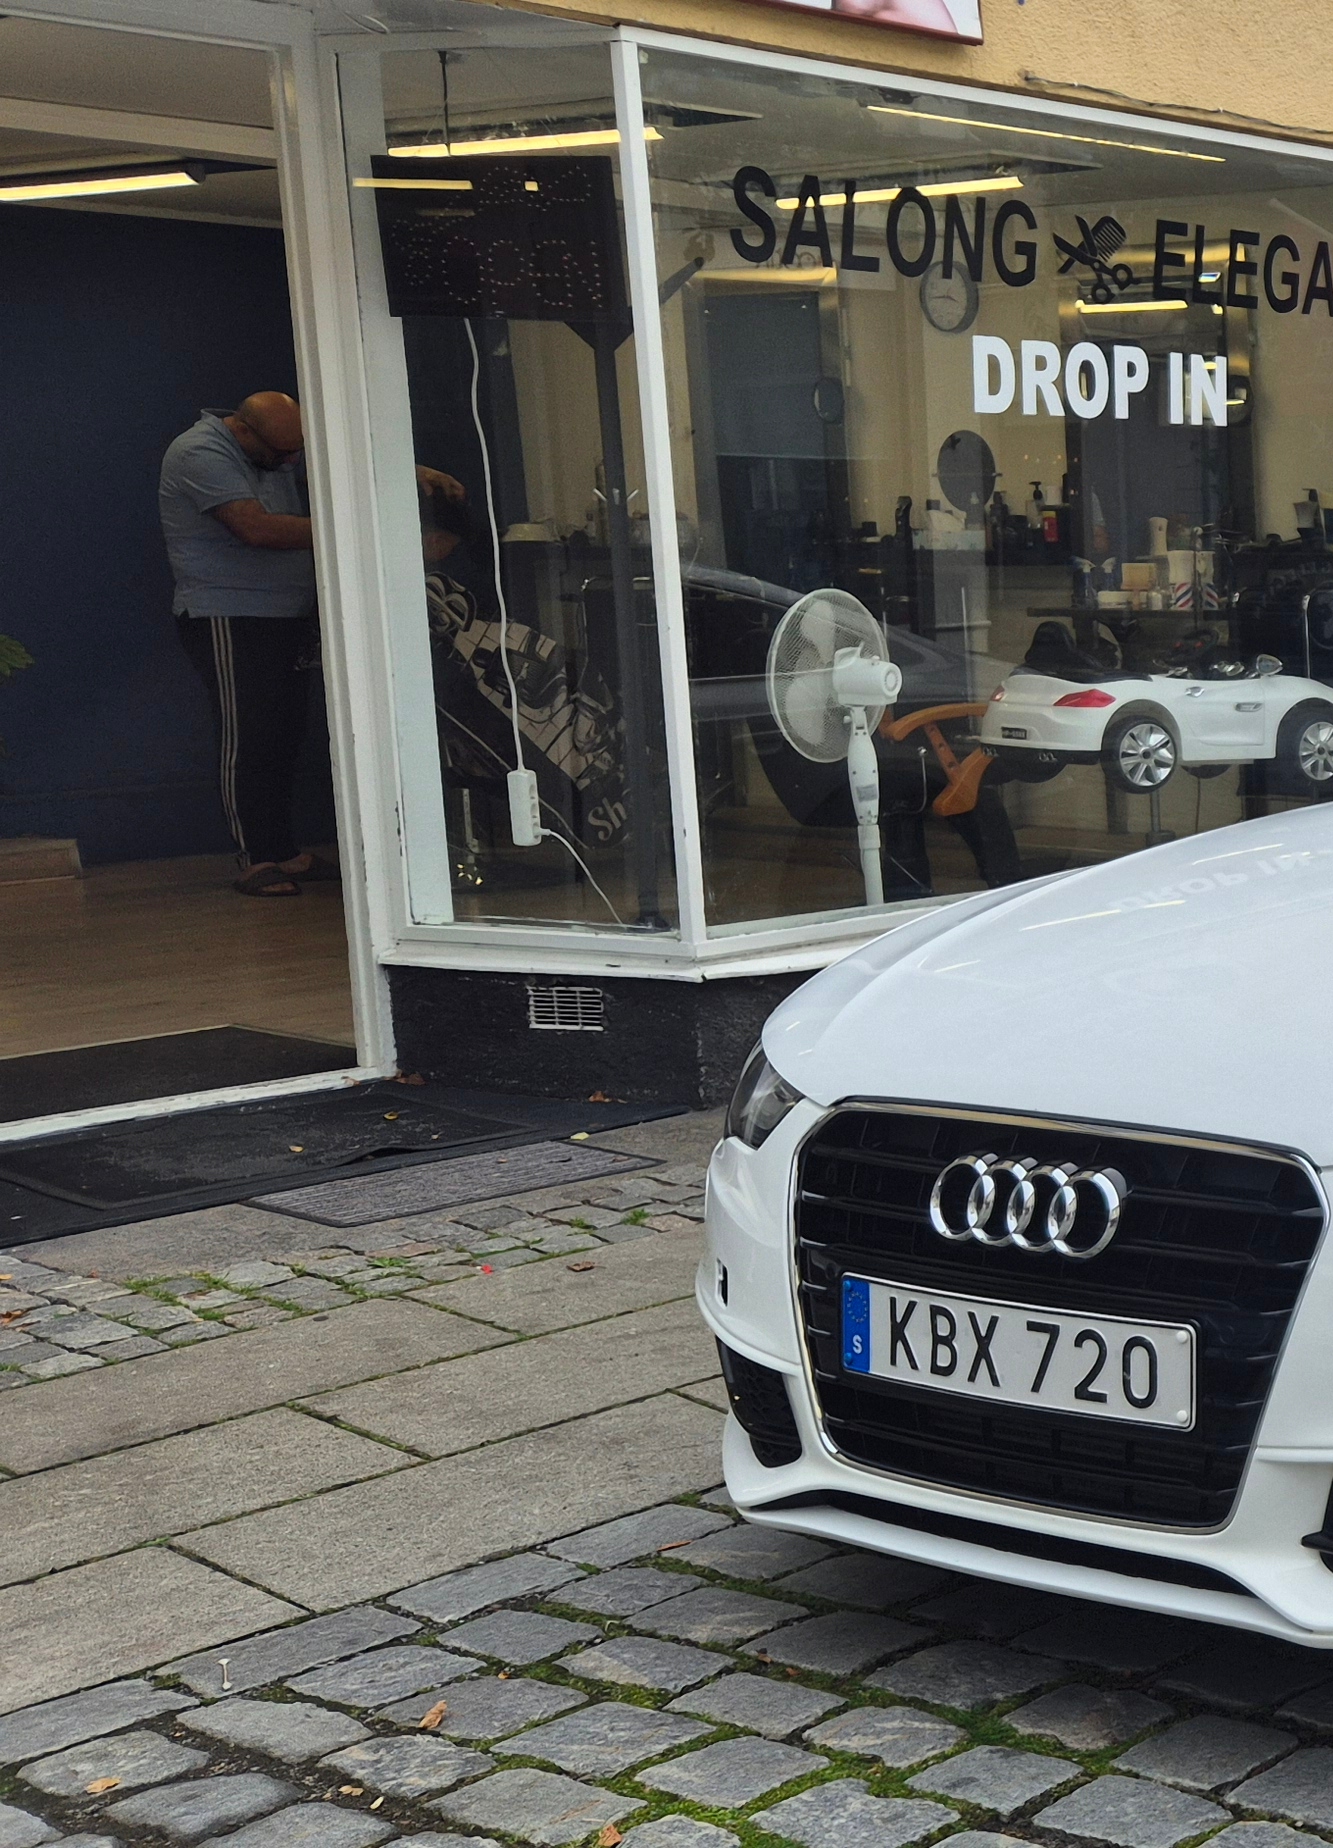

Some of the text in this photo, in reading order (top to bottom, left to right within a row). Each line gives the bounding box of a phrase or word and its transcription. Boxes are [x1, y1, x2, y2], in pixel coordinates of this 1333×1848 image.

[729, 165, 1038, 287] SALONG
[972, 335, 1228, 427] DROP IN
[587, 797, 628, 841] Sh
[853, 1334, 862, 1354] S
[889, 1296, 1158, 1409] KBX 720
